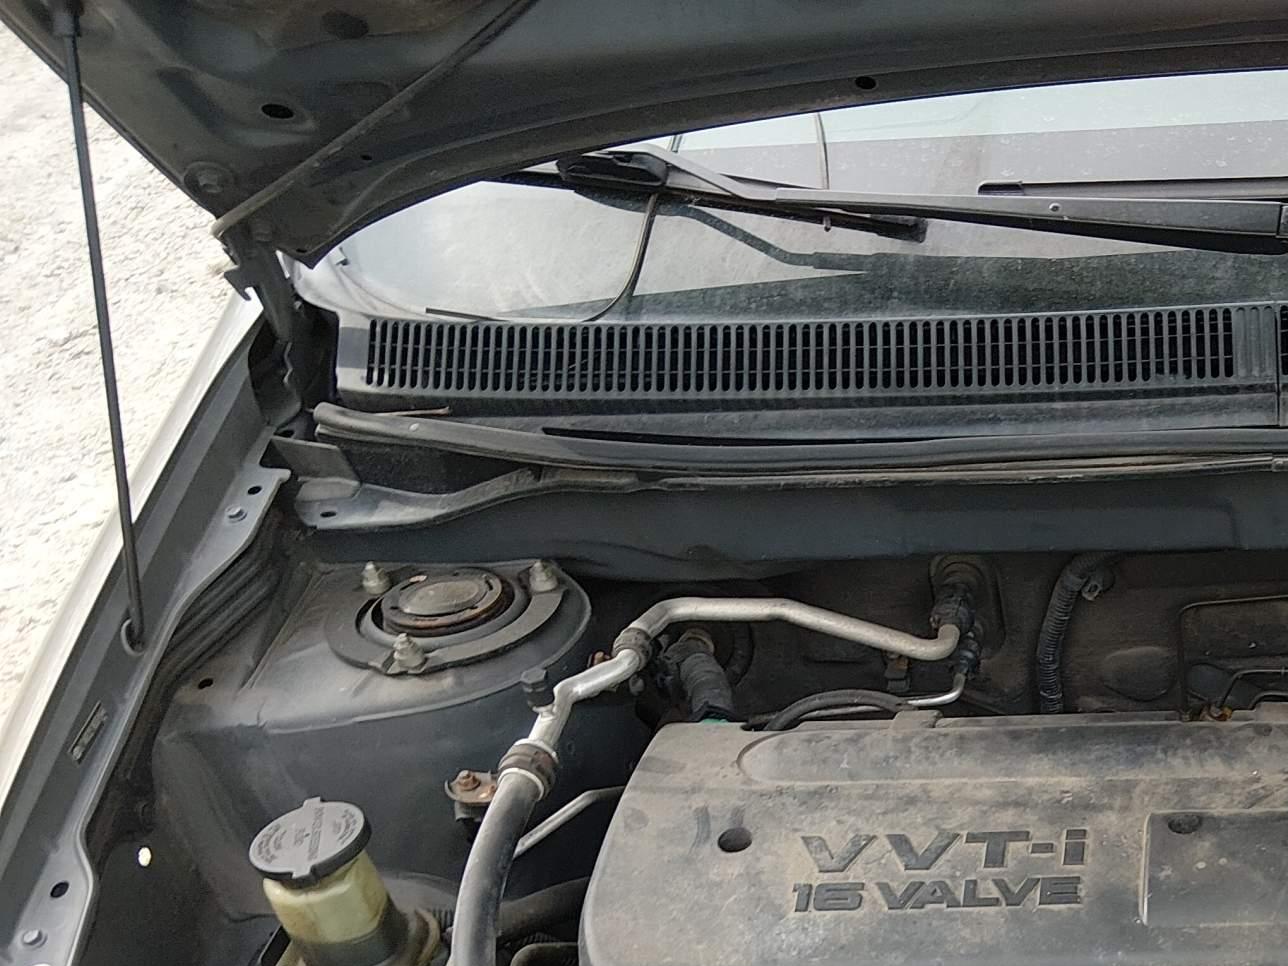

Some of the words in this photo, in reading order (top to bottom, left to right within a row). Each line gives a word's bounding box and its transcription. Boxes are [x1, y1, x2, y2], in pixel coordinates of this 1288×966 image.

[801, 828, 1087, 873] VVT-i
[793, 882, 866, 913] 16
[875, 876, 1082, 910] VALVE
